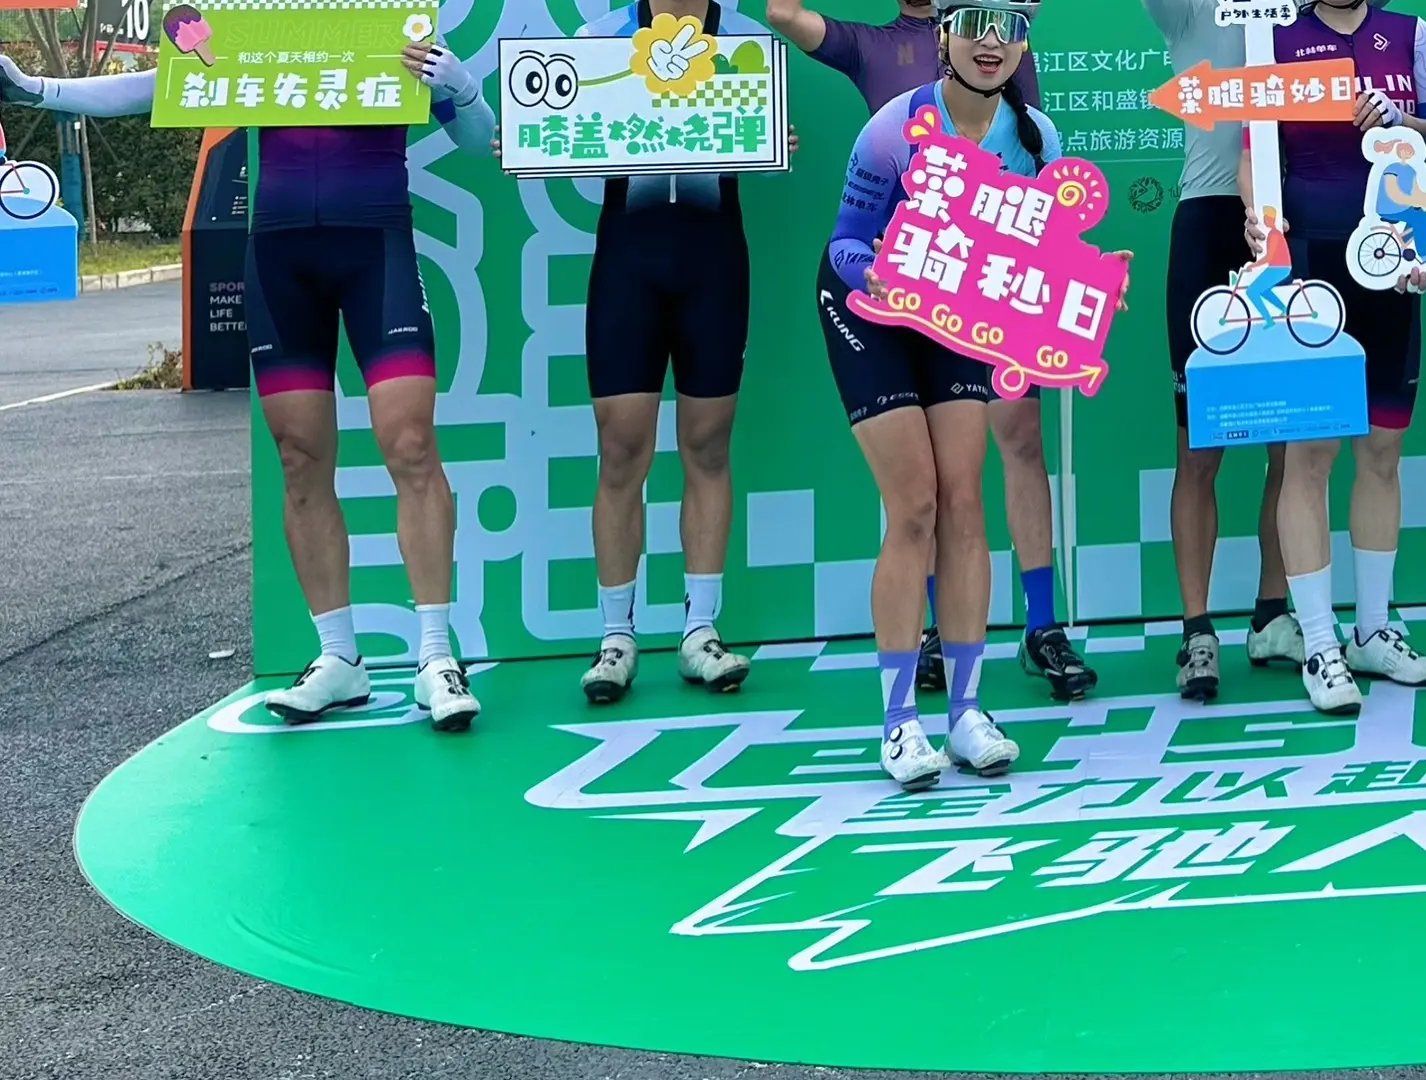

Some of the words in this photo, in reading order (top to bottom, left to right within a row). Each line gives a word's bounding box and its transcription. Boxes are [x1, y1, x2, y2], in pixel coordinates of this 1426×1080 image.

[1221, 4, 1292, 21] 户外生活季
[224, 20, 400, 50] SUMMER
[238, 51, 355, 64] 和这个夏天相约一次
[180, 69, 402, 111] 刹车失灵症
[1178, 74, 1352, 114] 菜腿骑妙日
[518, 110, 768, 161] 膝盖燃烧弹
[905, 145, 1056, 248] 菜腿
[210, 295, 243, 305] MAKE
[888, 223, 1108, 341] 骑秒日
[210, 308, 233, 318] LIFE
[887, 287, 921, 311] GO
[931, 304, 963, 333] GO
[971, 321, 1004, 345] GO
[1036, 345, 1068, 368] GO
